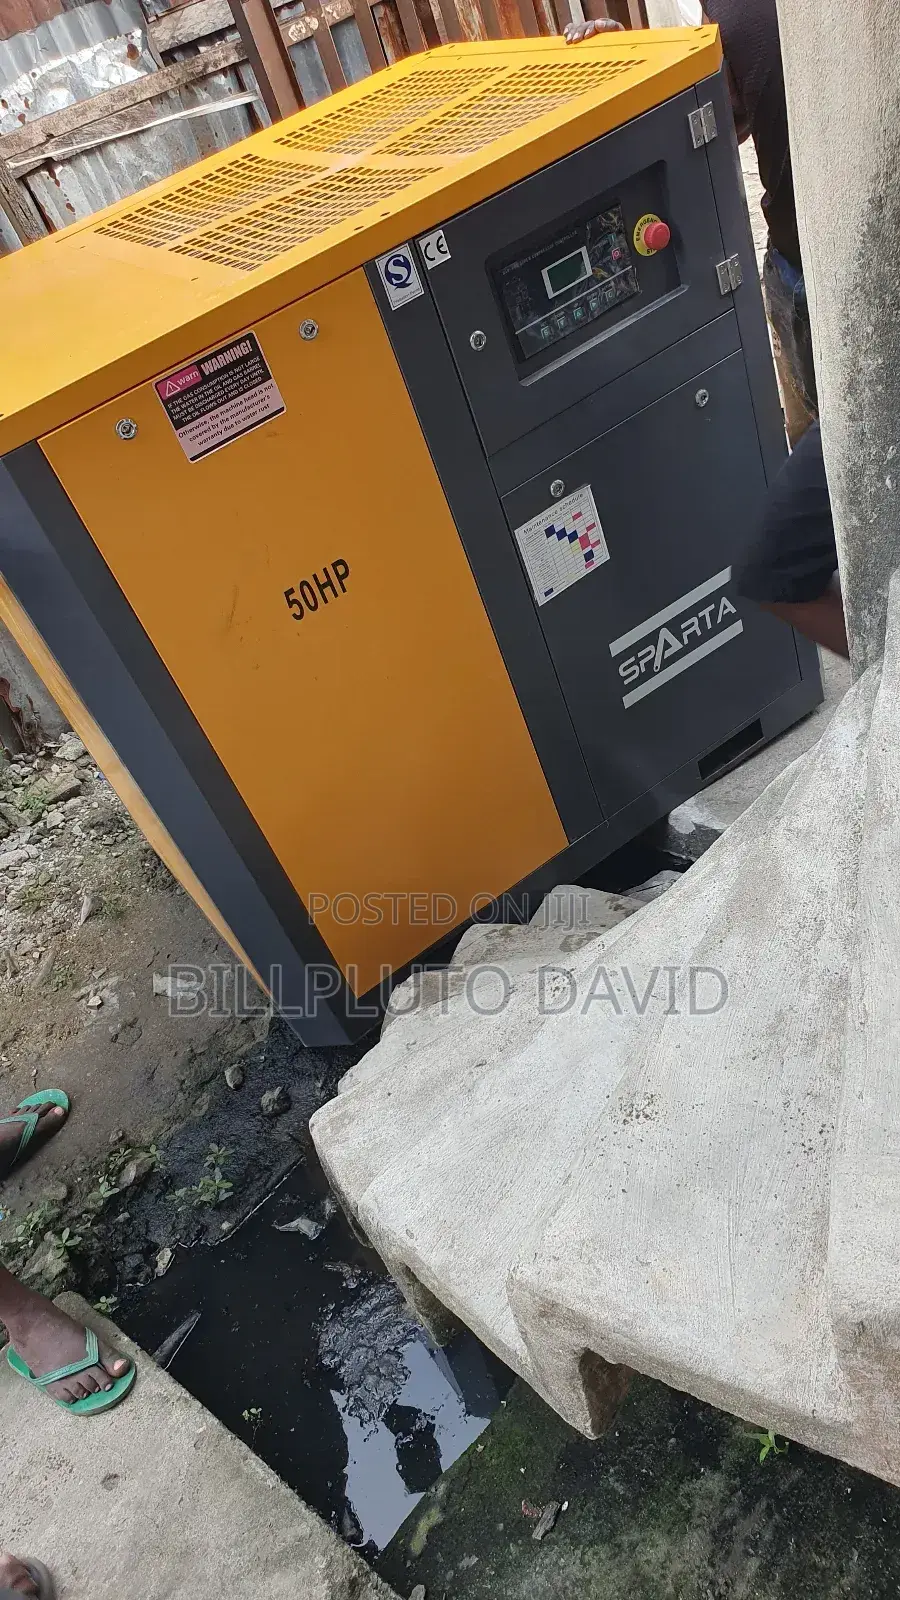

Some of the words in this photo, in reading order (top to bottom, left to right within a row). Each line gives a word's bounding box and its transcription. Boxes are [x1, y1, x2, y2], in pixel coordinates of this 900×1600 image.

[636, 218, 658, 241] EMERGEN
[424, 234, 448, 262] CE
[176, 370, 198, 385] warn
[200, 339, 252, 375] WARNING!
[219, 400, 243, 416] machine
[243, 391, 257, 402] head
[263, 383, 273, 391] not
[189, 425, 211, 441] covered
[197, 429, 222, 445] warranty
[241, 410, 257, 421] water
[258, 403, 269, 412] rust
[560, 492, 584, 512] schedule
[284, 558, 350, 620] 50HP
[618, 596, 736, 685] SPARTA
